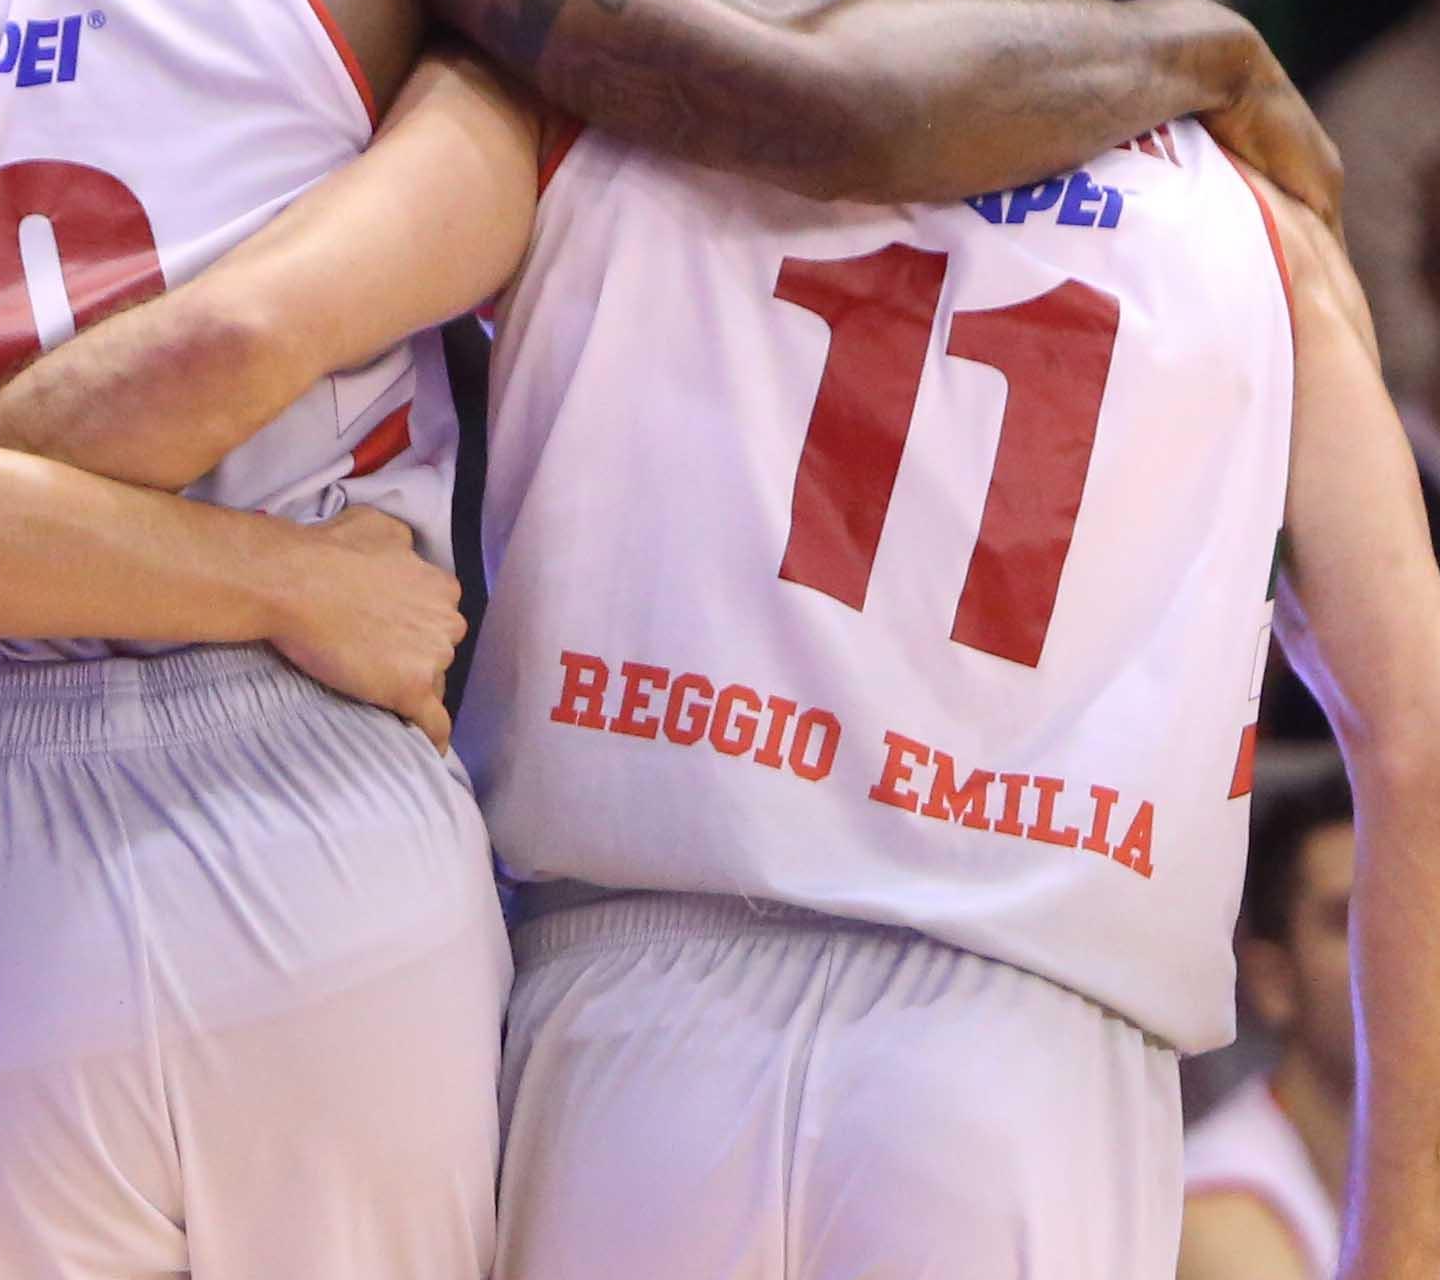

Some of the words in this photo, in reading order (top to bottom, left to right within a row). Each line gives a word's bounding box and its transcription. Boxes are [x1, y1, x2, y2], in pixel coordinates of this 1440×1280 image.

[773, 242, 1120, 669] 11
[550, 650, 842, 781] REGGIO
[868, 730, 1156, 879] EMILIA
